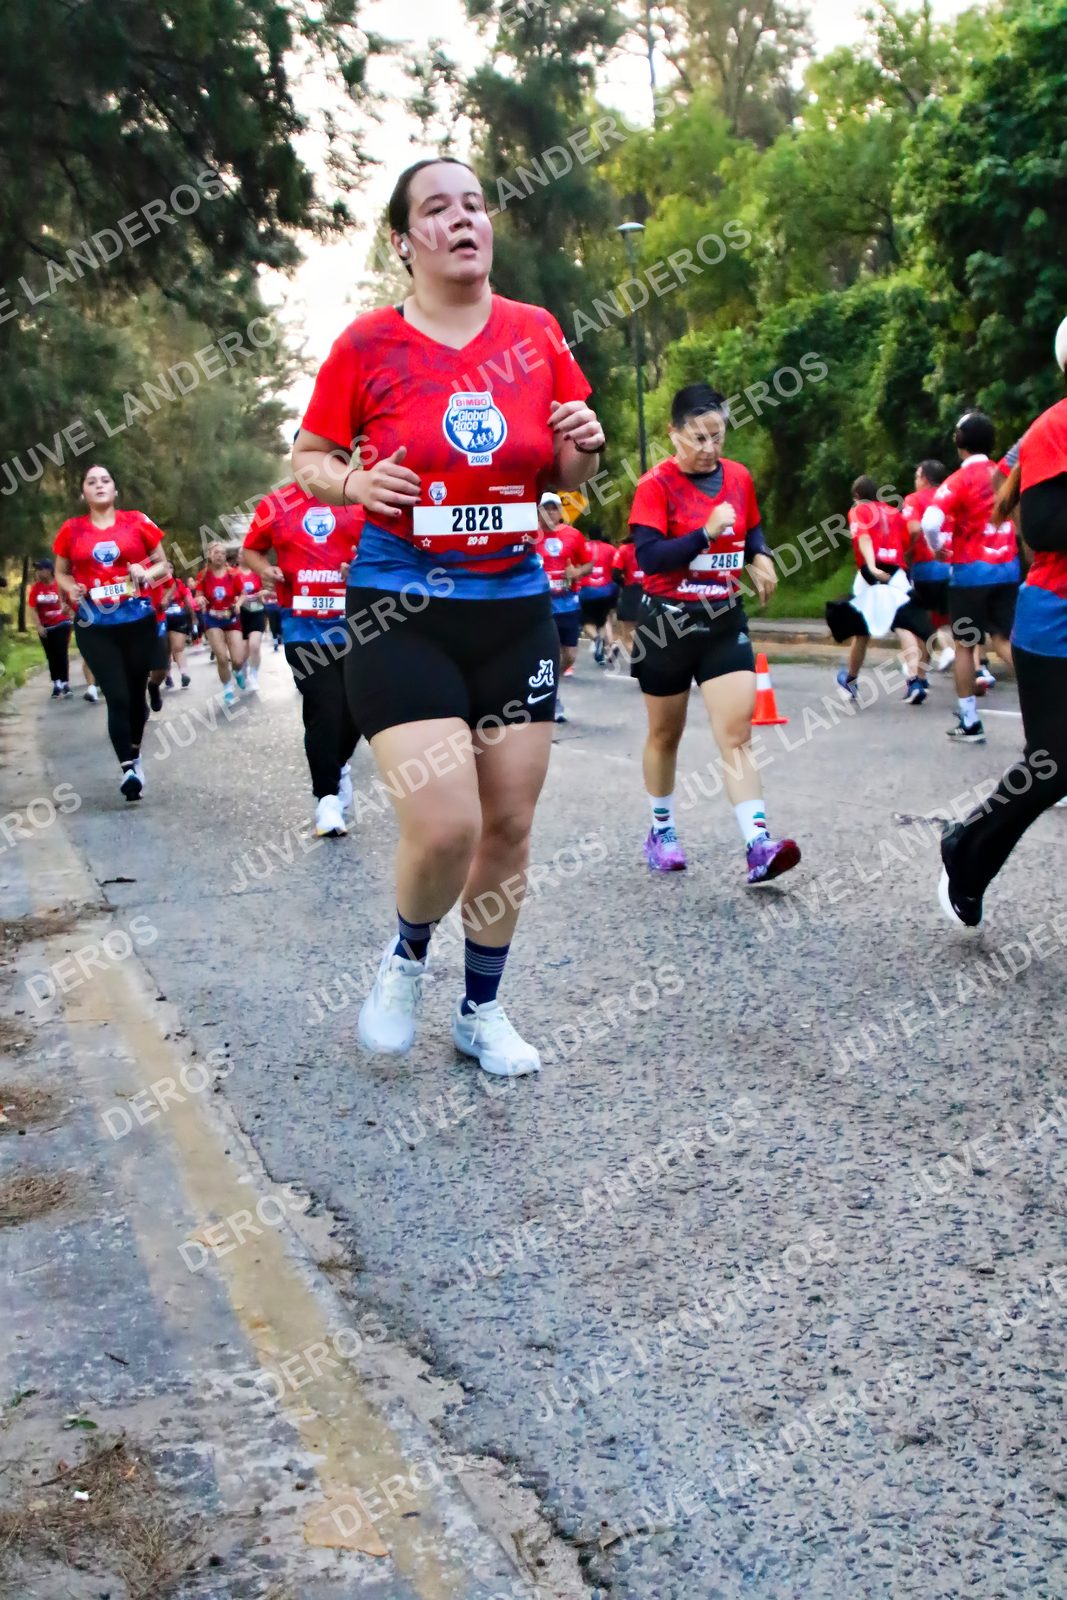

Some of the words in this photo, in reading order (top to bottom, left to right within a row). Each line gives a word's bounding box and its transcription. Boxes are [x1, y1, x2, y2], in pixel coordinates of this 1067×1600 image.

[455, 398, 488, 407] BIMBO
[457, 409, 490, 423] Global
[453, 420, 479, 432] Race
[470, 455, 490, 464] 2026
[452, 505, 503, 532] 2828
[710, 553, 739, 569] 2486
[312, 597, 335, 609] 3312
